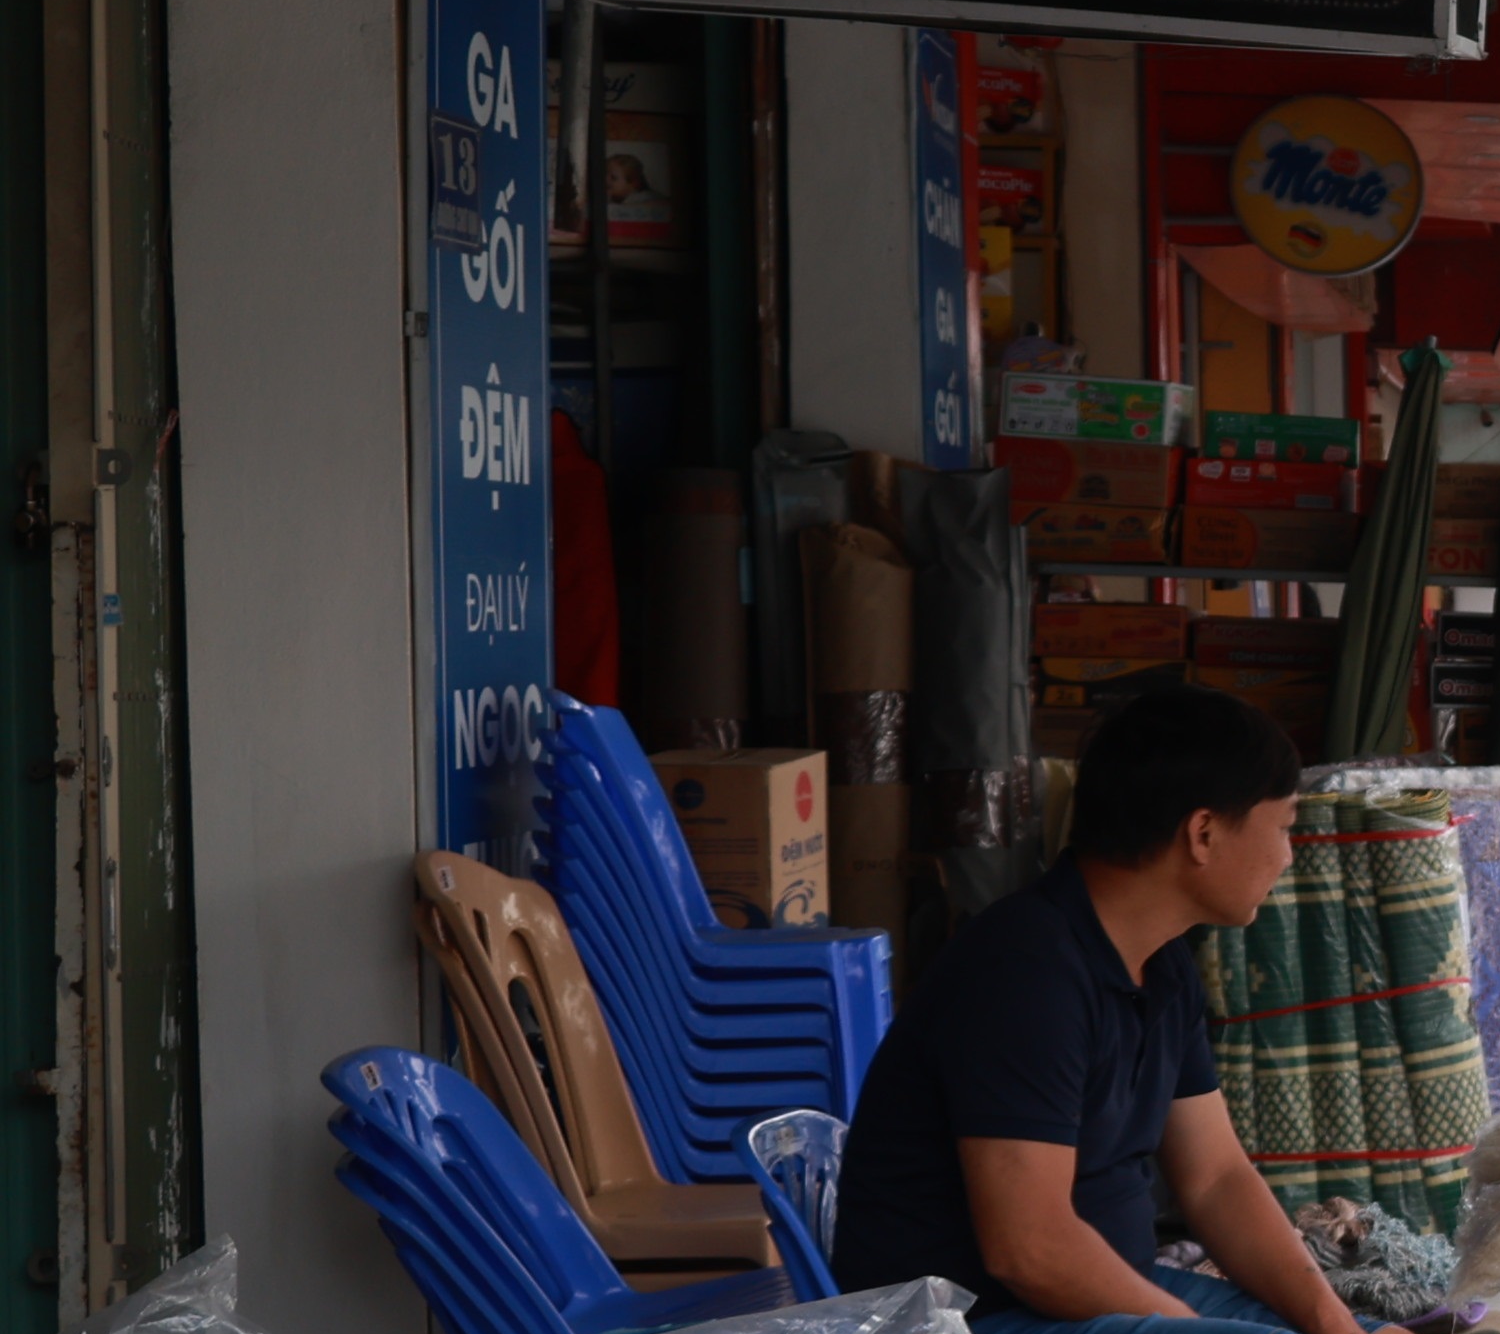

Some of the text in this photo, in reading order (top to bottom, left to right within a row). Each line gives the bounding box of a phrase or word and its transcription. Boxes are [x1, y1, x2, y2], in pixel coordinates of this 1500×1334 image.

[467, 31, 519, 140] GA
[438, 132, 476, 196] 13
[1263, 141, 1387, 216] Monte
[461, 178, 525, 313] GỐI
[924, 177, 960, 249] CHĂN
[936, 287, 956, 346] GA
[459, 361, 530, 511] ĐỆM
[935, 372, 962, 448] GỐI
[465, 561, 530, 647] ĐẠI LÝ
